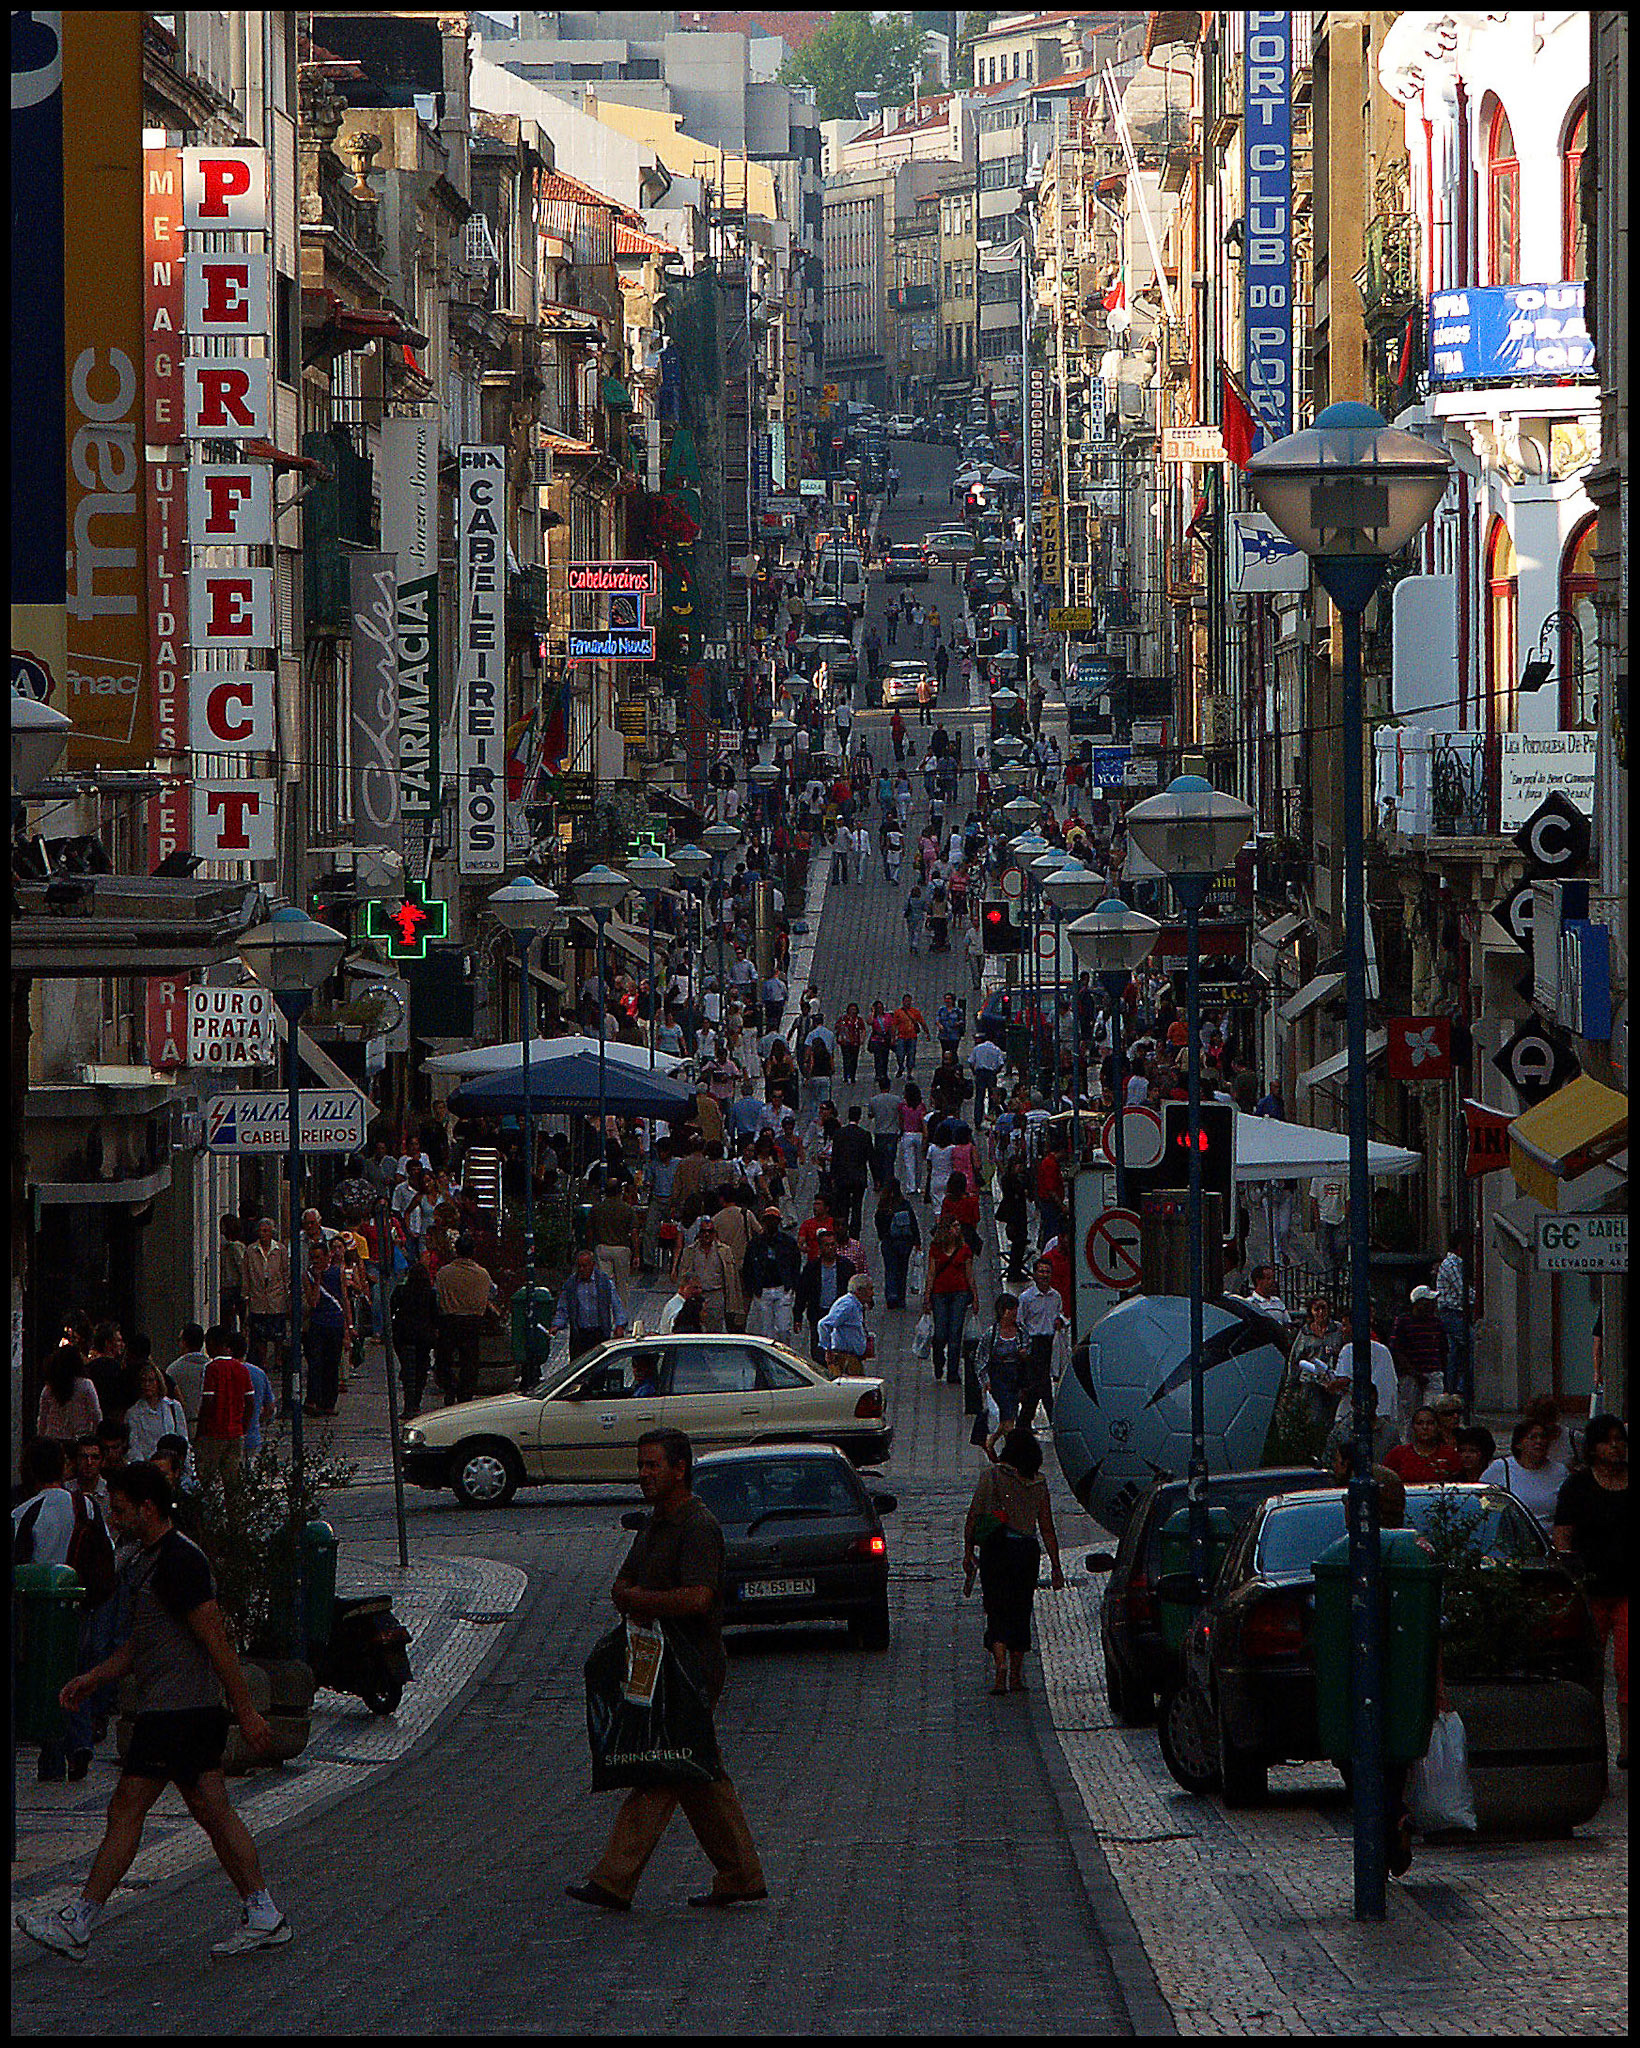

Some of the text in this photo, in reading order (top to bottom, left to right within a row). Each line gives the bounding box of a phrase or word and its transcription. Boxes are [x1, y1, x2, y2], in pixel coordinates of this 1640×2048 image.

[1250, 145, 1285, 265] CLUB
[149, 170, 174, 423] MENAGE
[1250, 285, 1285, 308] DO
[66, 347, 138, 621] fnac
[198, 160, 260, 849] PERFECT
[569, 568, 650, 589] Cabeleireiros
[154, 469, 177, 750] UTILIDADES
[569, 633, 652, 655] Fernando Nunes
[467, 479, 498, 850] CABELEIREIROS
[67, 671, 139, 696] fnac
[399, 589, 431, 814] FARMACIA
[194, 992, 264, 1014] OURO
[193, 1018, 263, 1039] PRATA
[193, 1042, 261, 1062] JOIAS
[605, 1747, 693, 1766] SPRINGFIELD
